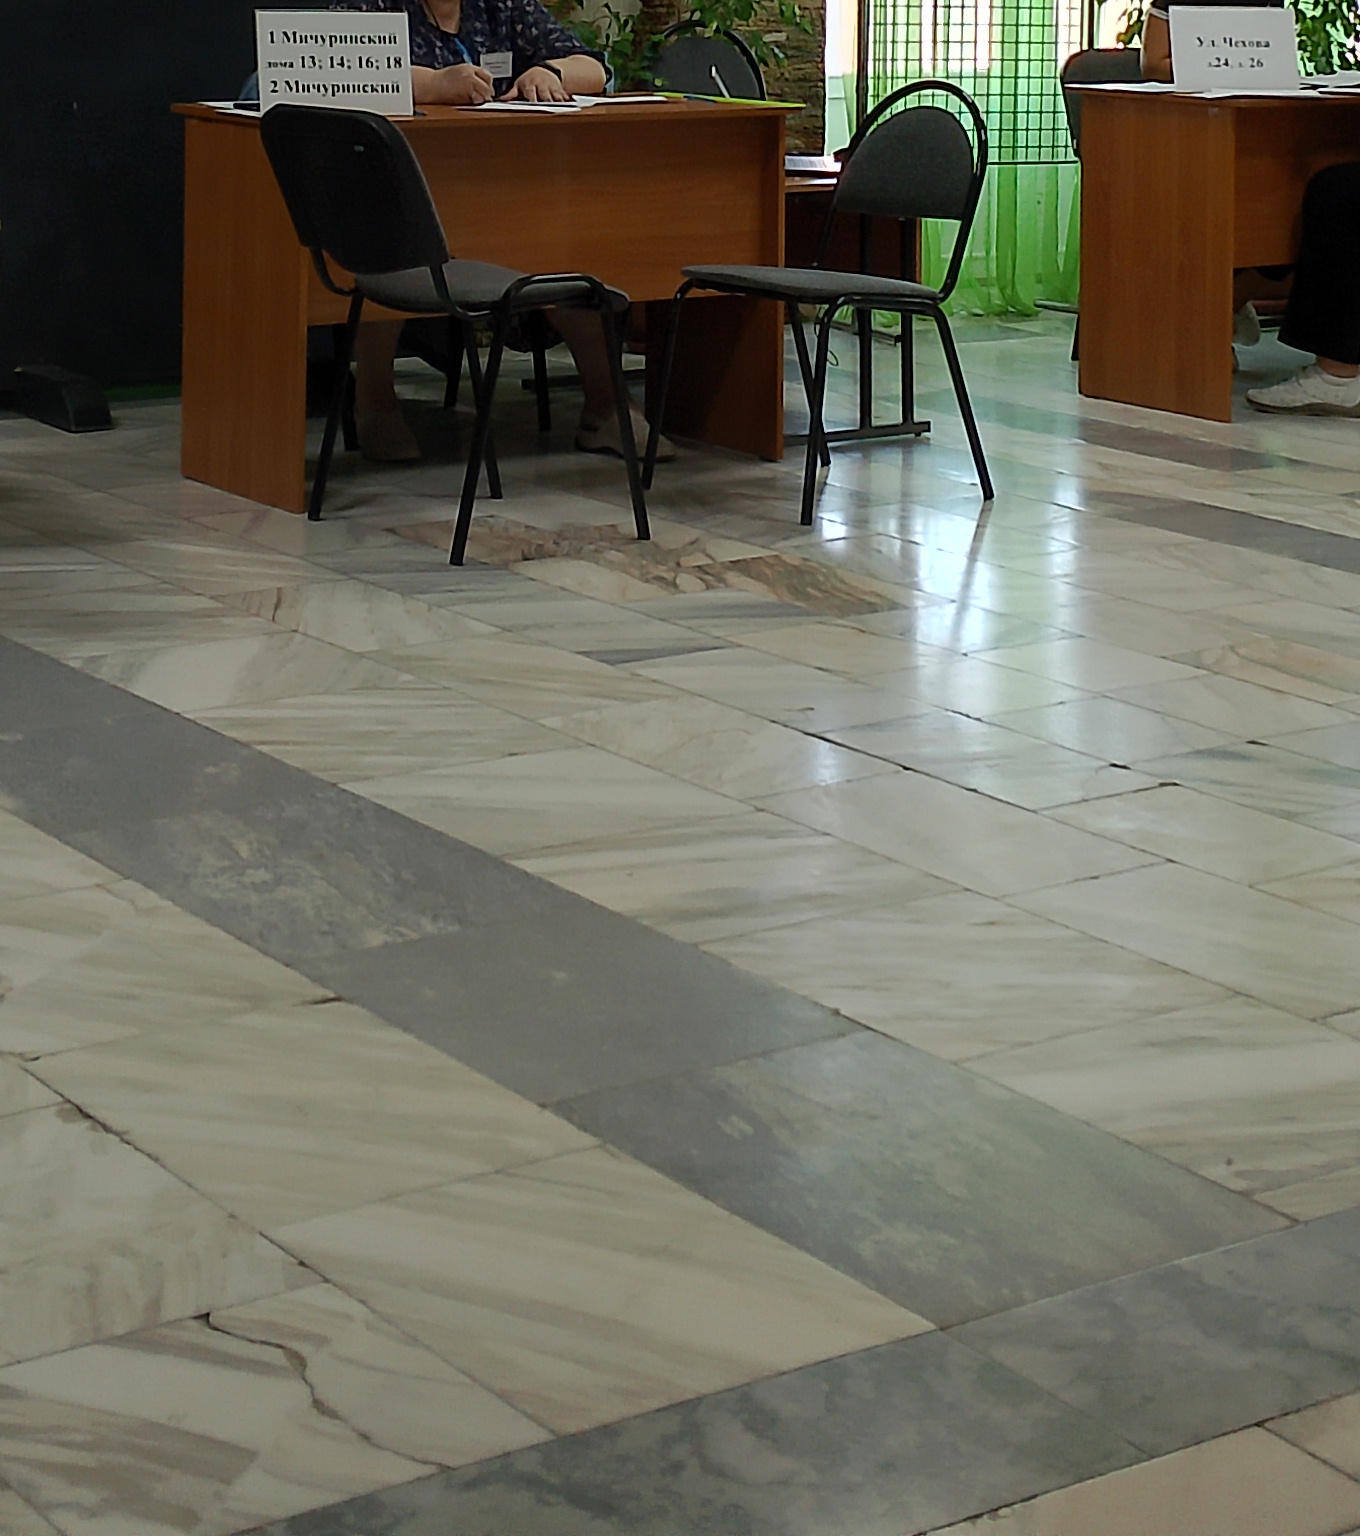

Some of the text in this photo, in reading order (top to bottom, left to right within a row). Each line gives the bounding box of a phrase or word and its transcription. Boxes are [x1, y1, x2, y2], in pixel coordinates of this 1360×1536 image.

[269, 30, 398, 47] 1 Мичуринский
[1223, 36, 1270, 48] Чехова
[265, 55, 403, 70] дома 13; 14; 16; 18
[1249, 57, 1264, 69] 26
[270, 80, 401, 97] 2 Мичуринский
